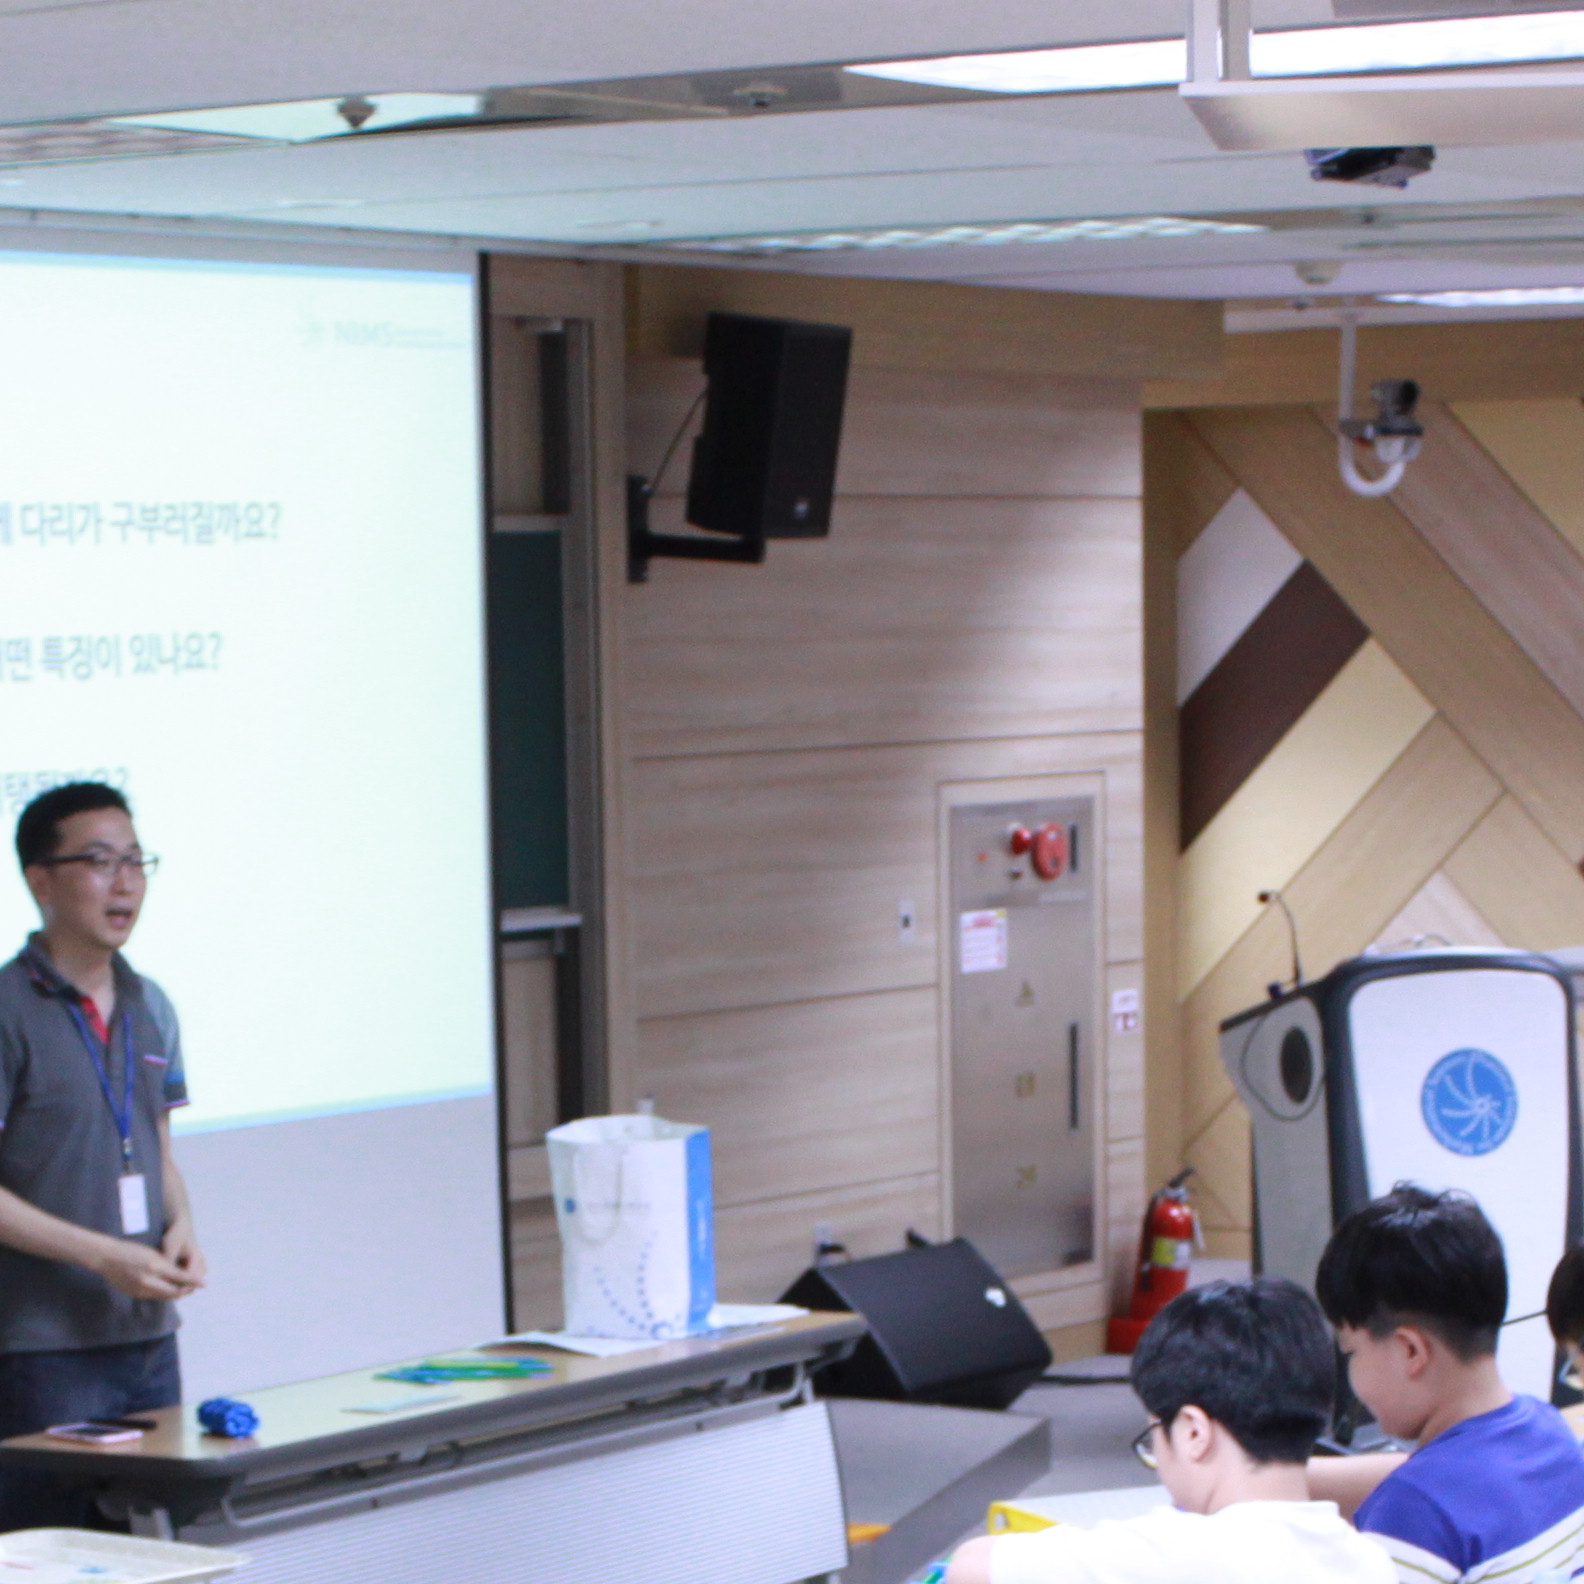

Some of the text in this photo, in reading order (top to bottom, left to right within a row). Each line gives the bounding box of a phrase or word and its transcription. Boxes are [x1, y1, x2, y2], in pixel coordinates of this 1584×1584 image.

[19, 499, 105, 547] 다리가
[109, 498, 281, 547] 구부러질까요?
[40, 632, 121, 682] 특징이
[129, 630, 224, 678] 있나요?
